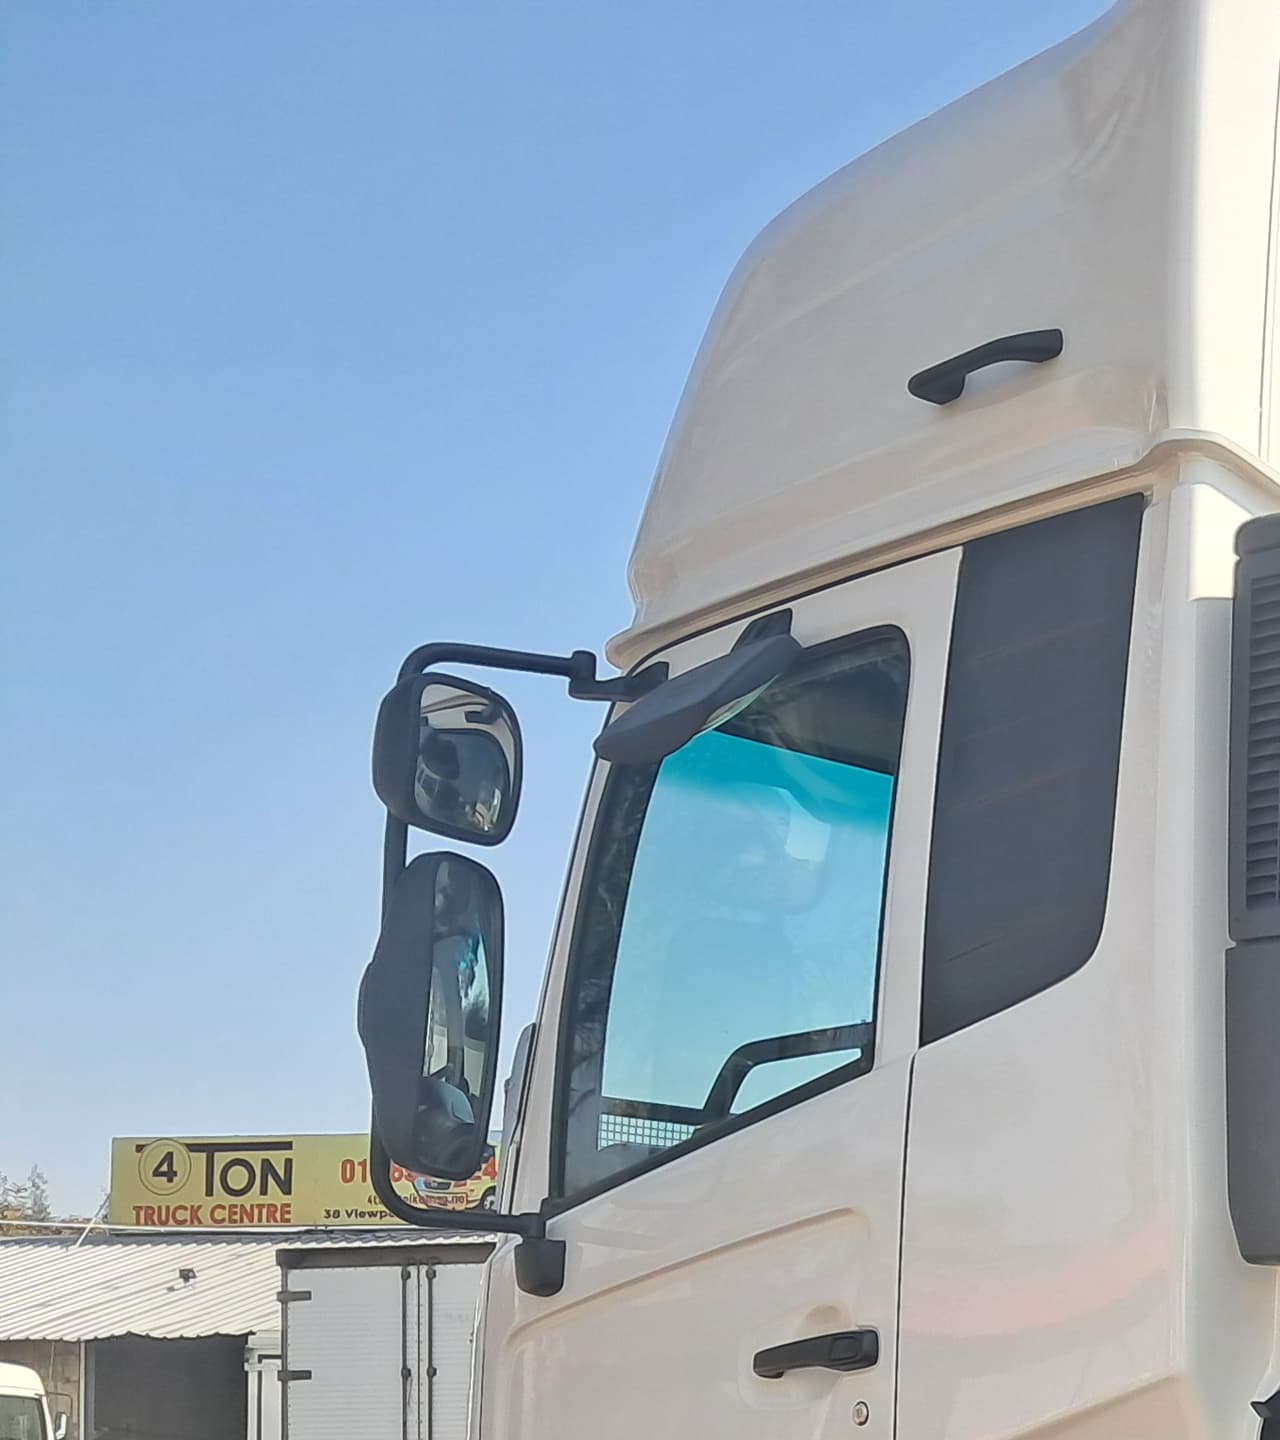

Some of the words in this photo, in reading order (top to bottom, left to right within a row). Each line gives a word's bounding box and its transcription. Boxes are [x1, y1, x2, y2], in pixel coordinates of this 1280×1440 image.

[152, 1151, 178, 1183] 4
[187, 1141, 293, 1197] TON
[340, 1158, 368, 1184] 01
[132, 1205, 203, 1225] TRUCK
[209, 1203, 292, 1225] CENTRE
[323, 1208, 341, 1220] 38
